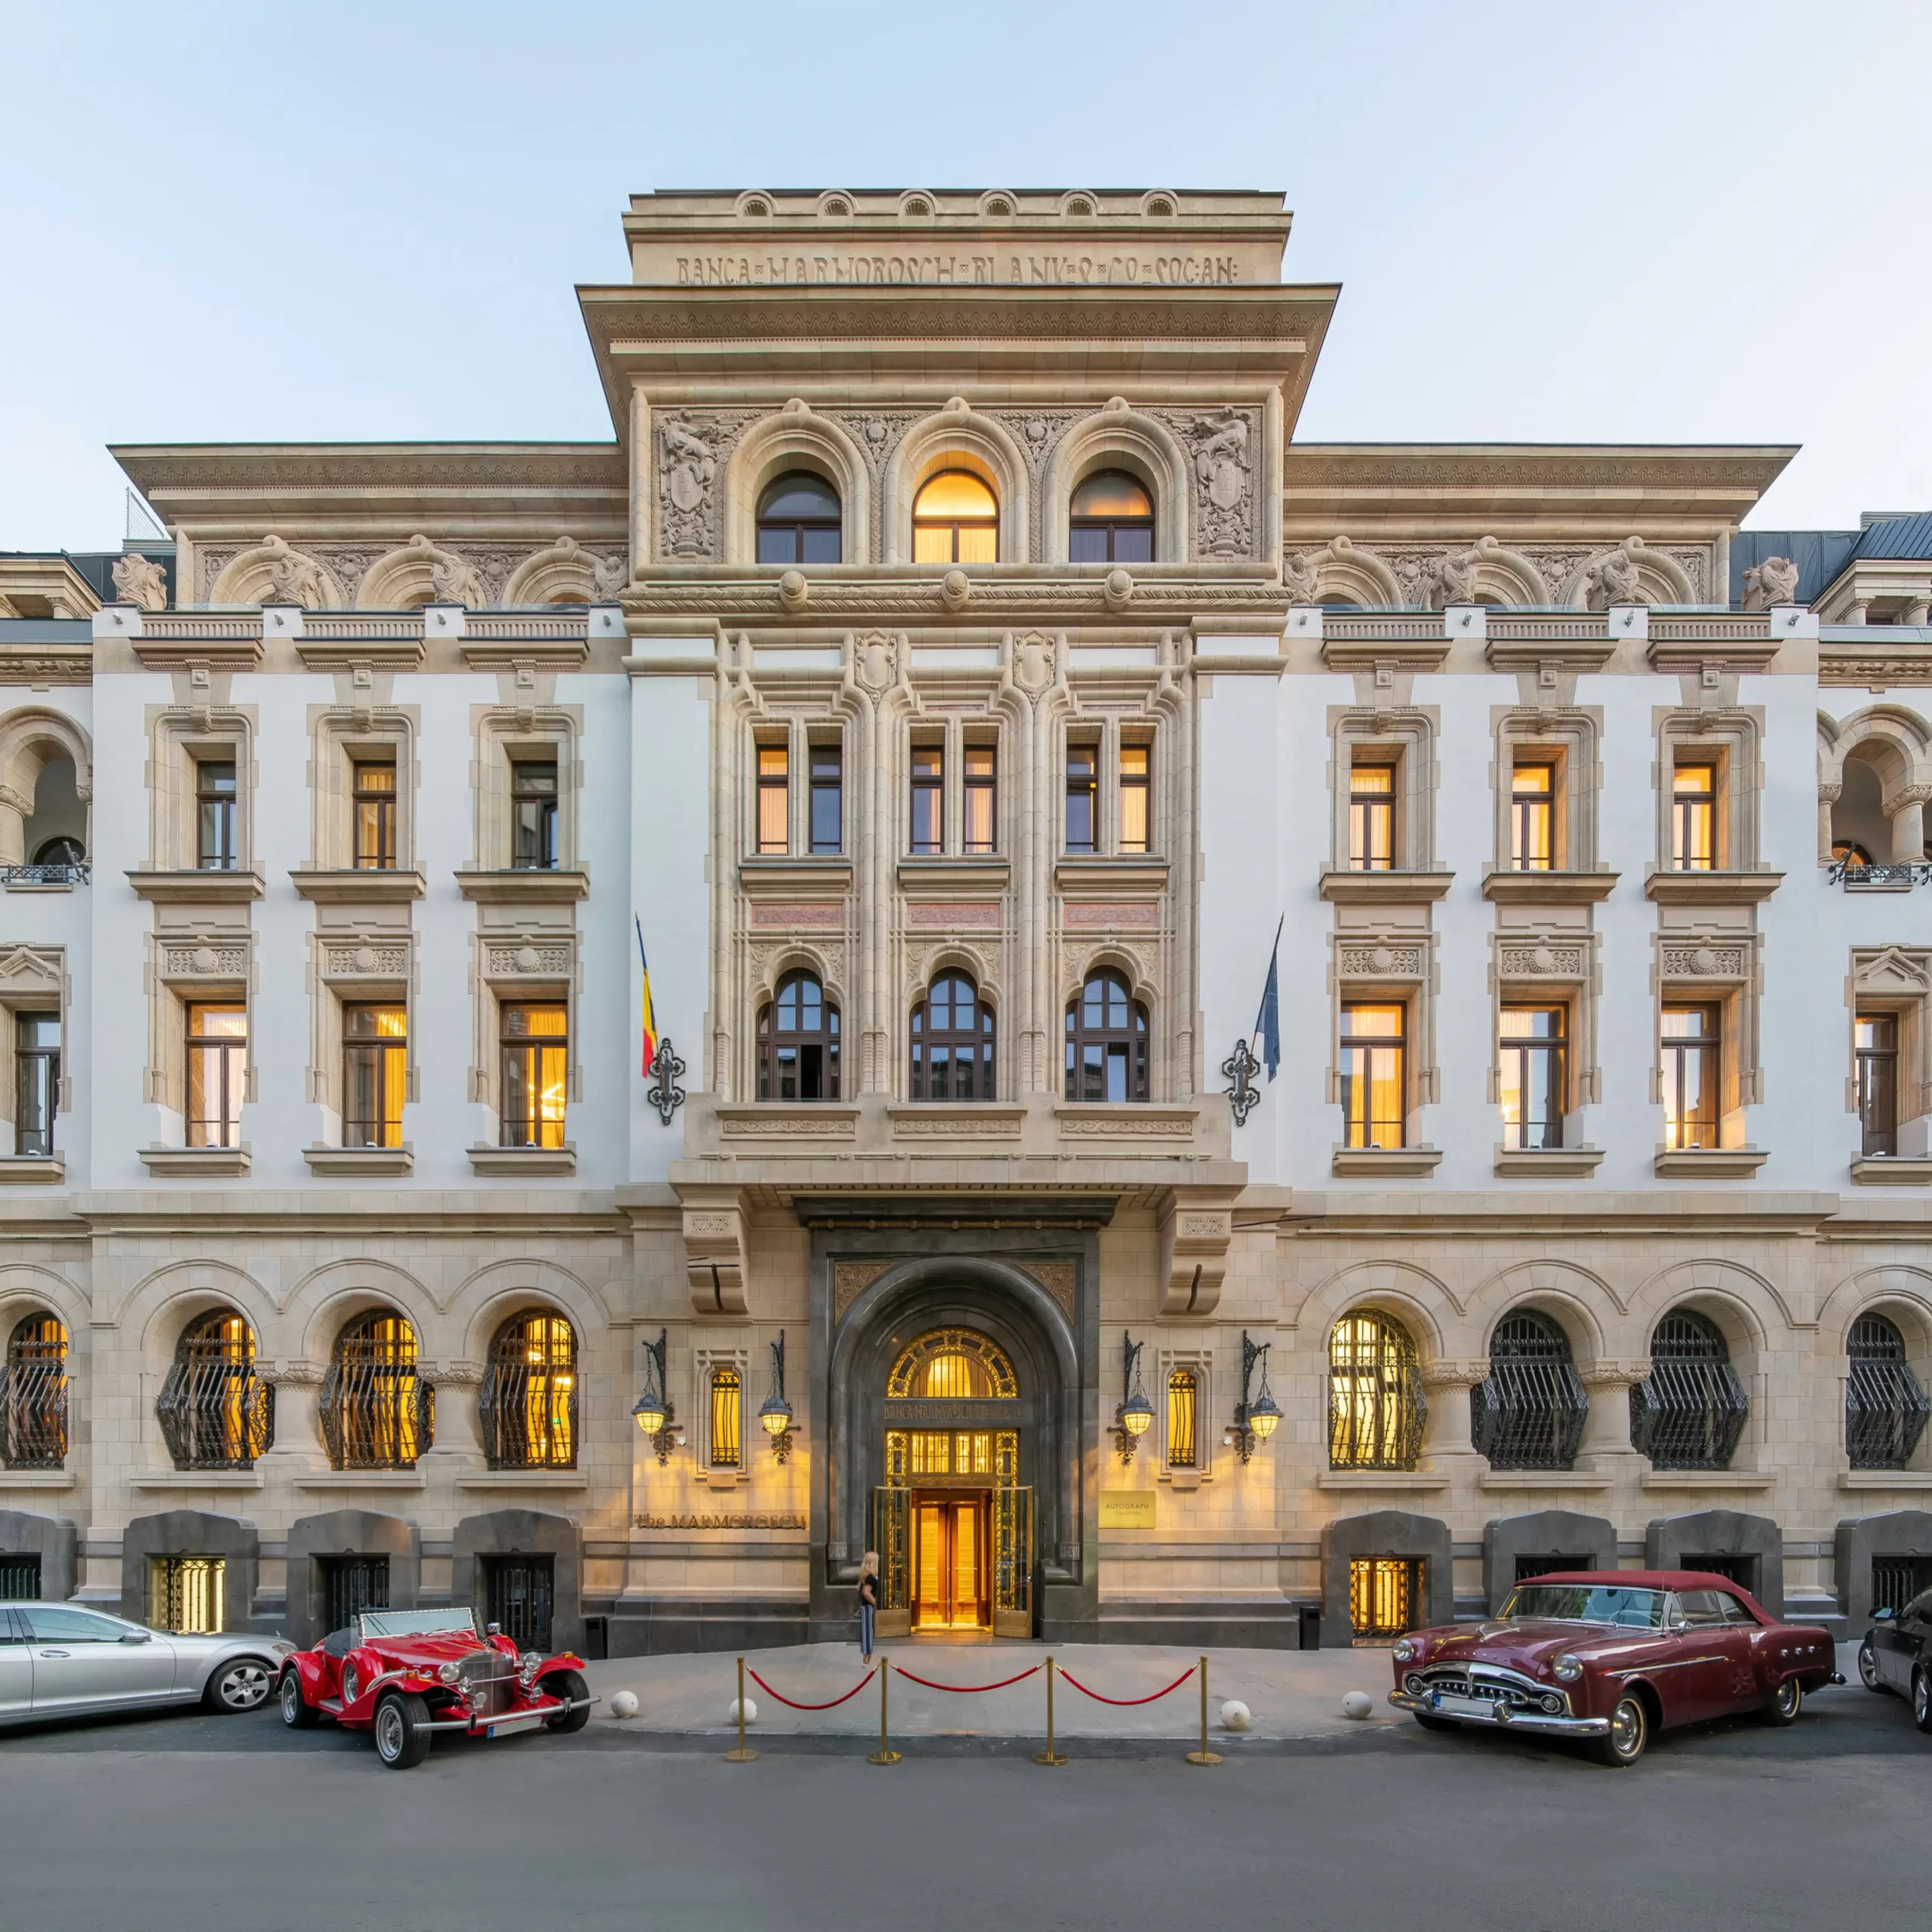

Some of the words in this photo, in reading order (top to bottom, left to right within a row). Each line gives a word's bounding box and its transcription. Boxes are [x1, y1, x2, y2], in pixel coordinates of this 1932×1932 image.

[675, 257, 752, 285] BANCA
[766, 257, 956, 284] MARMOROSCH
[1107, 257, 1138, 284] CO
[884, 1404, 913, 1420] BANCA
[635, 1514, 665, 1528] The
[672, 1515, 807, 1530] MARMOROSCH
